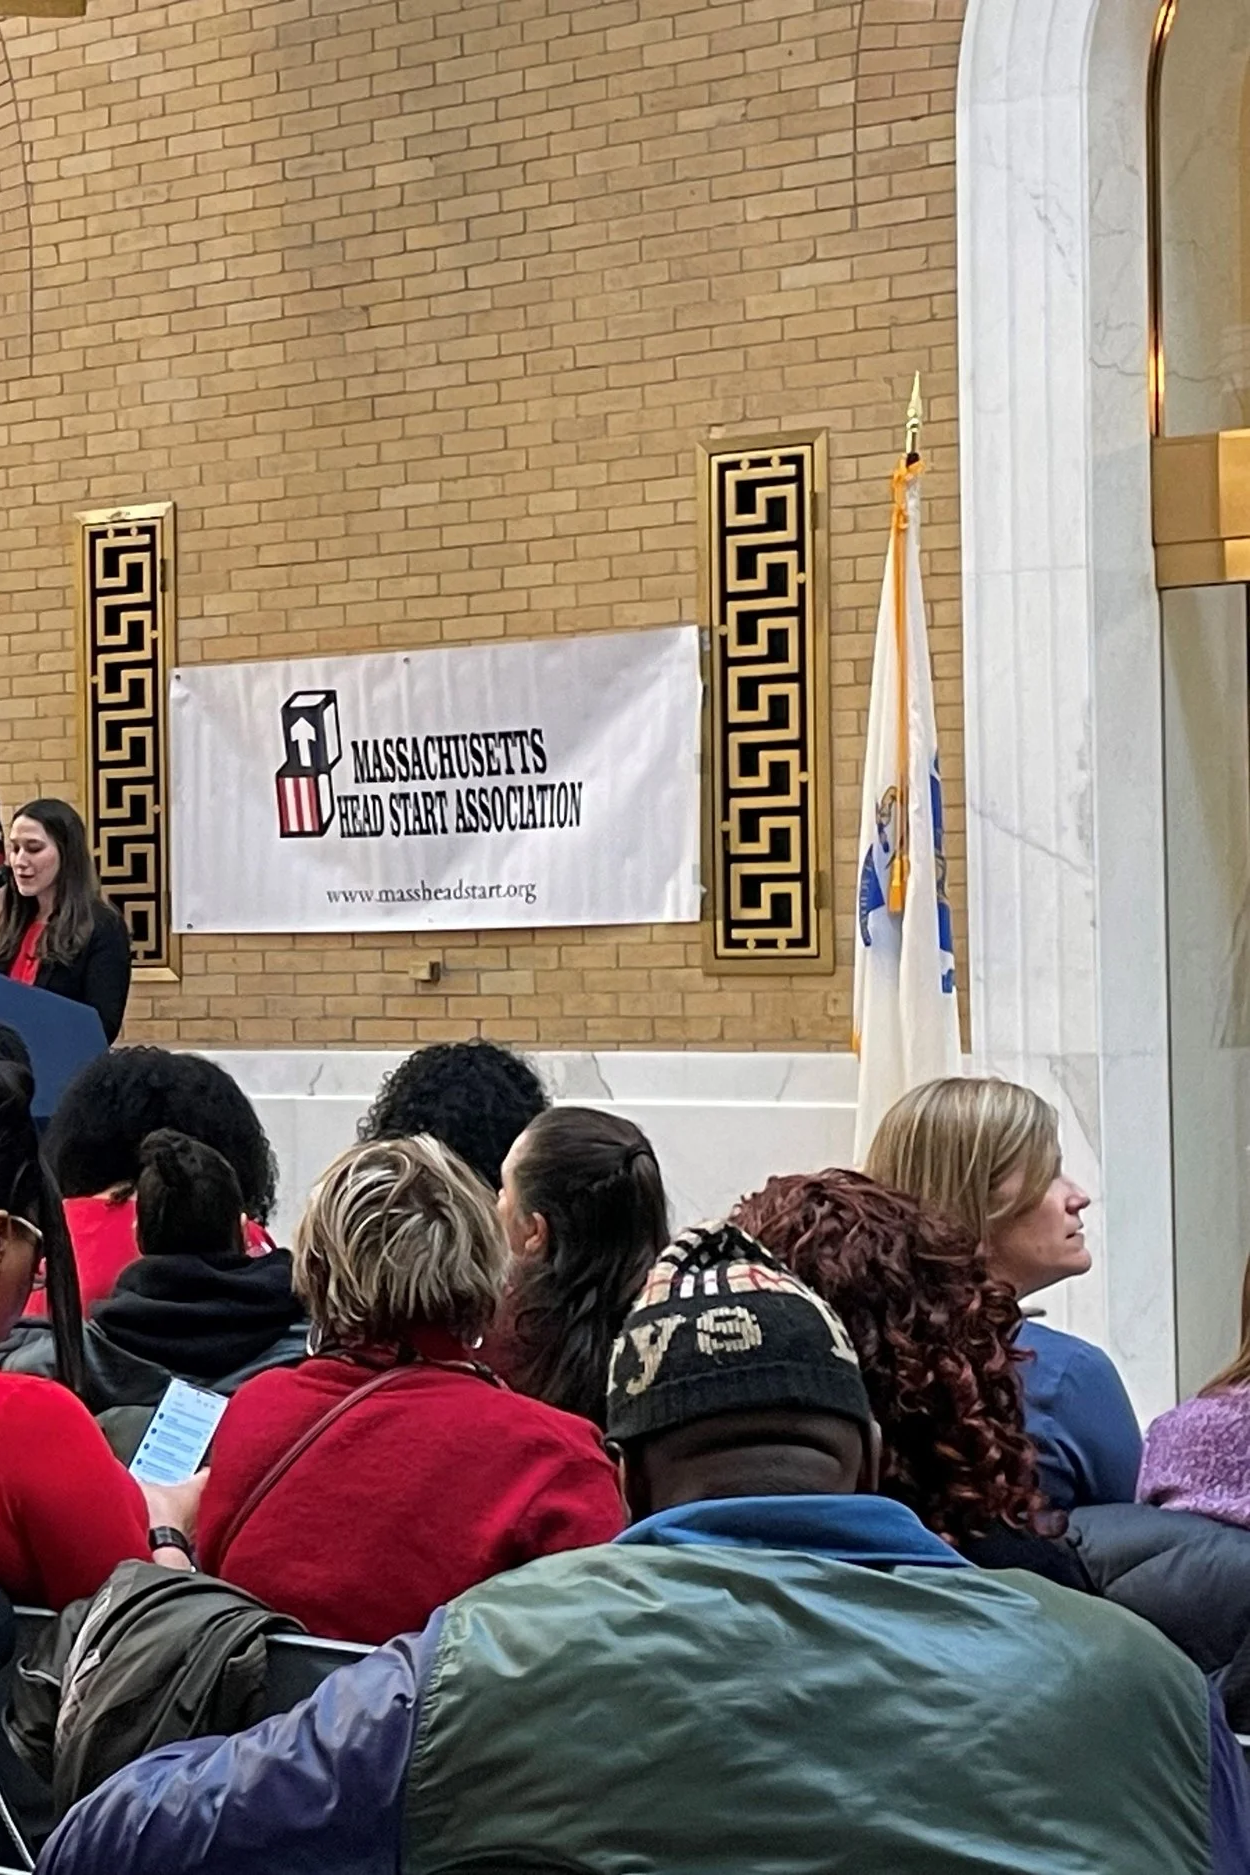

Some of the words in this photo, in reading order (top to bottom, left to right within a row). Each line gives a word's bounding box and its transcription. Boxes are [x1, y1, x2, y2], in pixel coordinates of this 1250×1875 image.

[350, 727, 548, 784] MASSACHUSETTS
[336, 794, 385, 839] HEAD
[389, 790, 449, 837] START
[455, 781, 583, 834] ASSOCIATION
[326, 879, 538, 904] www.massheadstart.org
